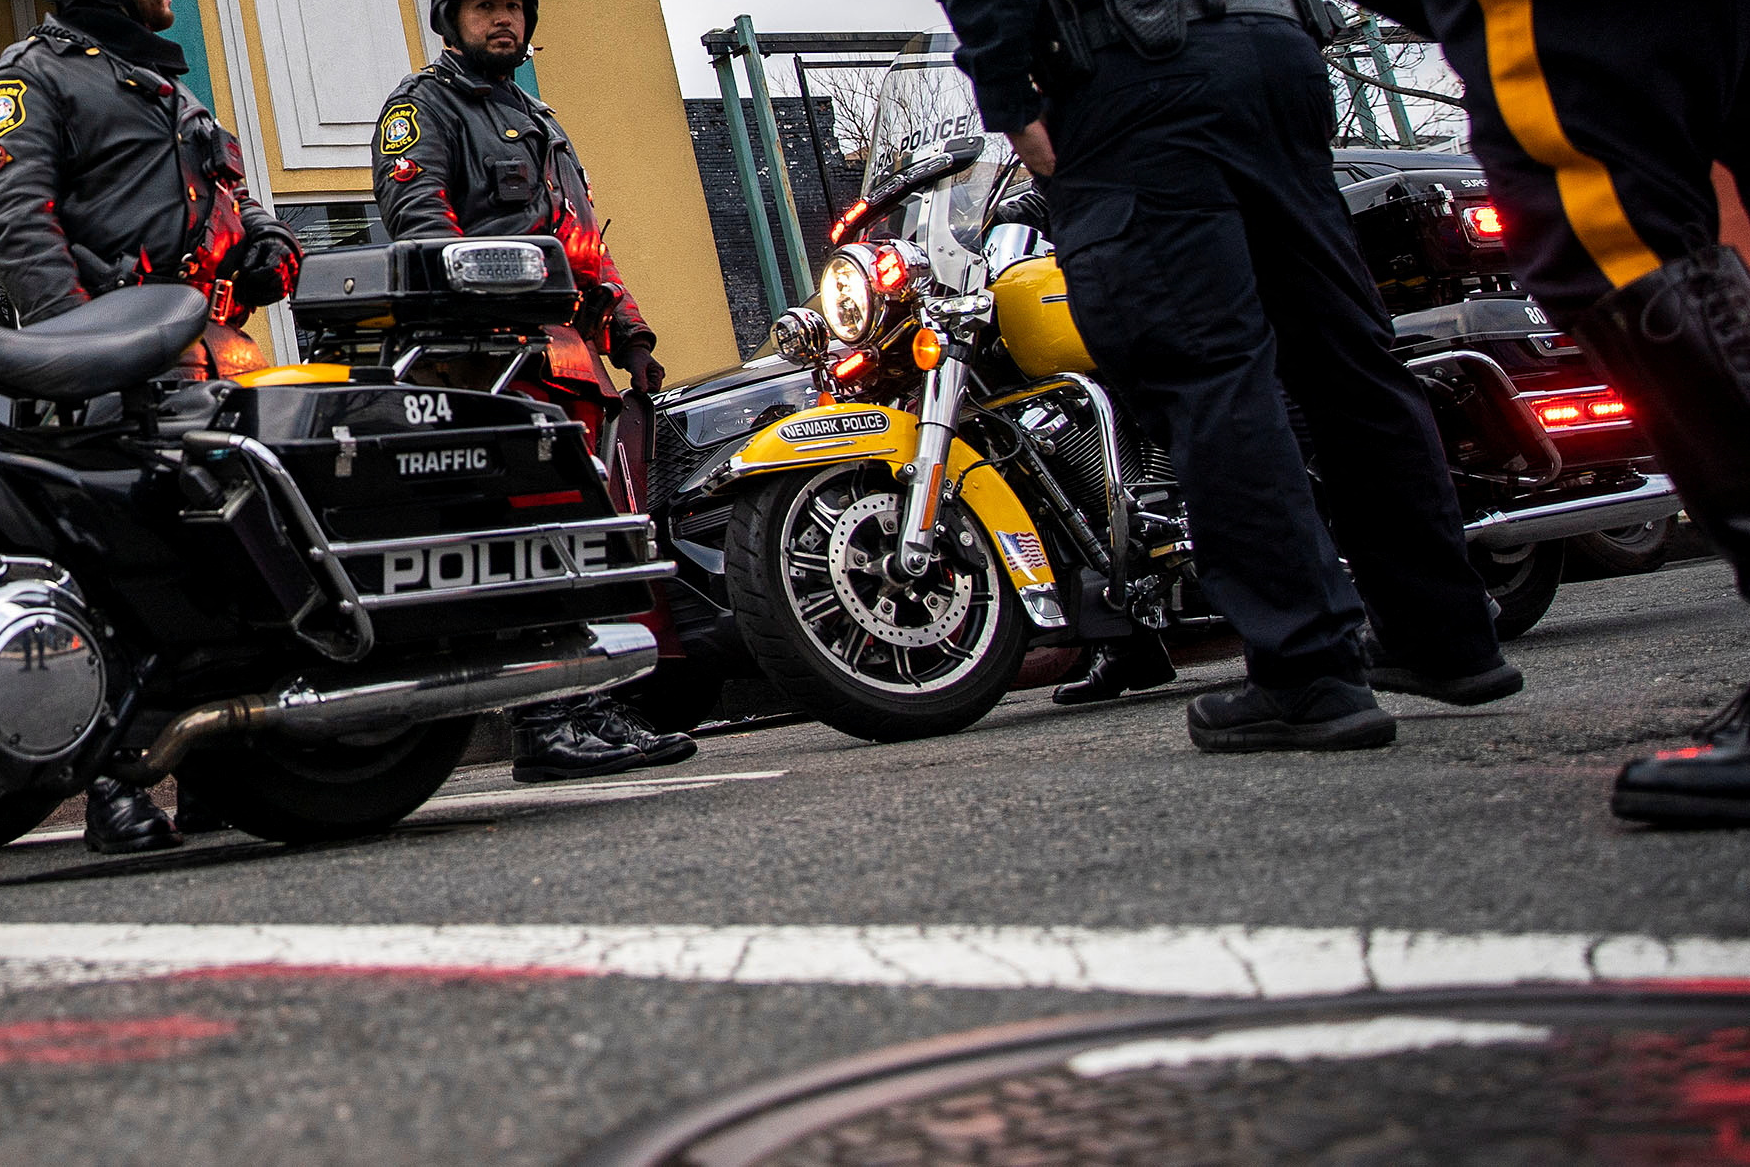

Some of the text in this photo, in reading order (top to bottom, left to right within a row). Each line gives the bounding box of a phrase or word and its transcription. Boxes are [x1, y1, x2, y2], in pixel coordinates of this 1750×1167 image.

[385, 135, 413, 150] POLICE
[898, 114, 968, 157] POLICE
[403, 393, 453, 425] 824
[783, 414, 884, 438] NEWARK POLICE
[396, 447, 488, 475] TRAFFIC
[383, 532, 609, 594] POLICE
